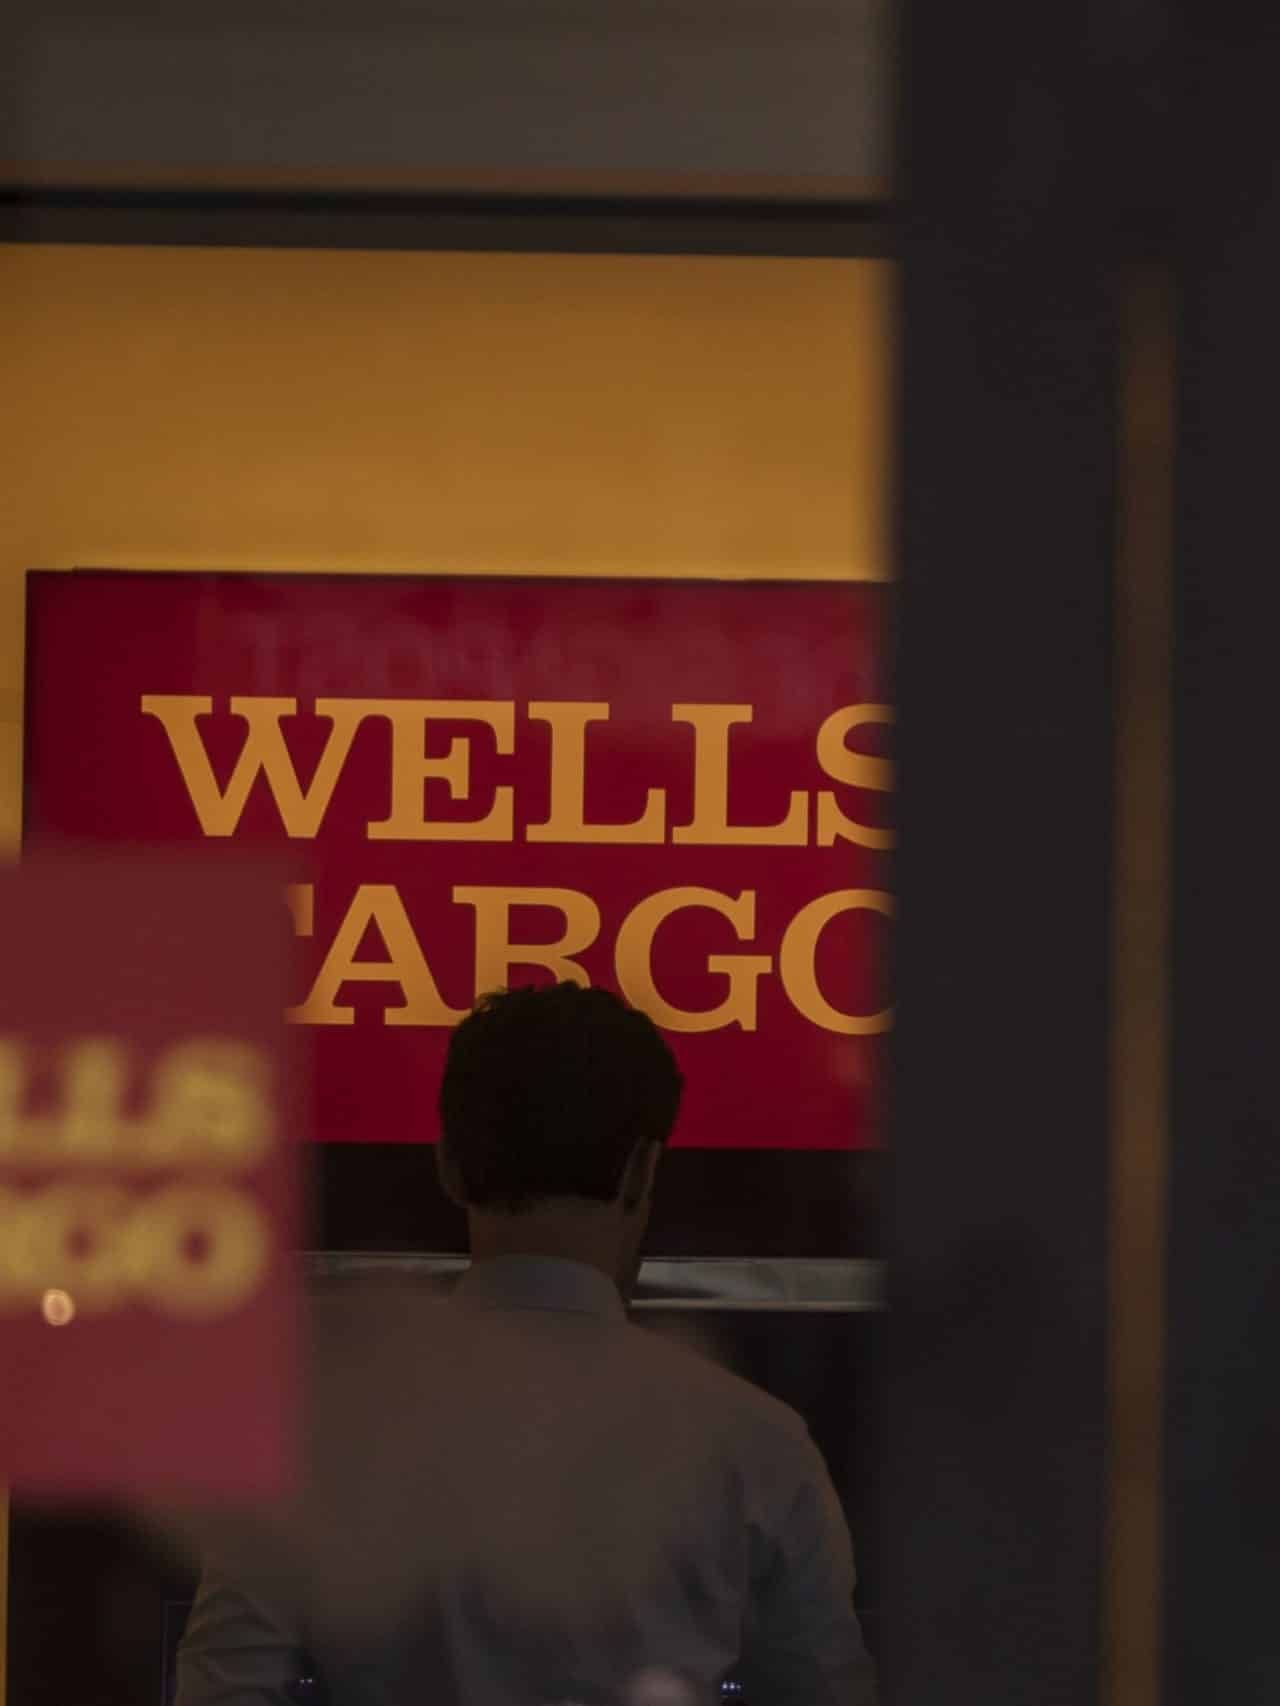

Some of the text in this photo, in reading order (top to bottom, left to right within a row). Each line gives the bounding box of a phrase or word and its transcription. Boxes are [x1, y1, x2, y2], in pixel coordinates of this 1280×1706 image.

[141, 694, 890, 850] WELLS
[287, 884, 890, 1035] ARGO
[0, 1190, 270, 1318] GO
